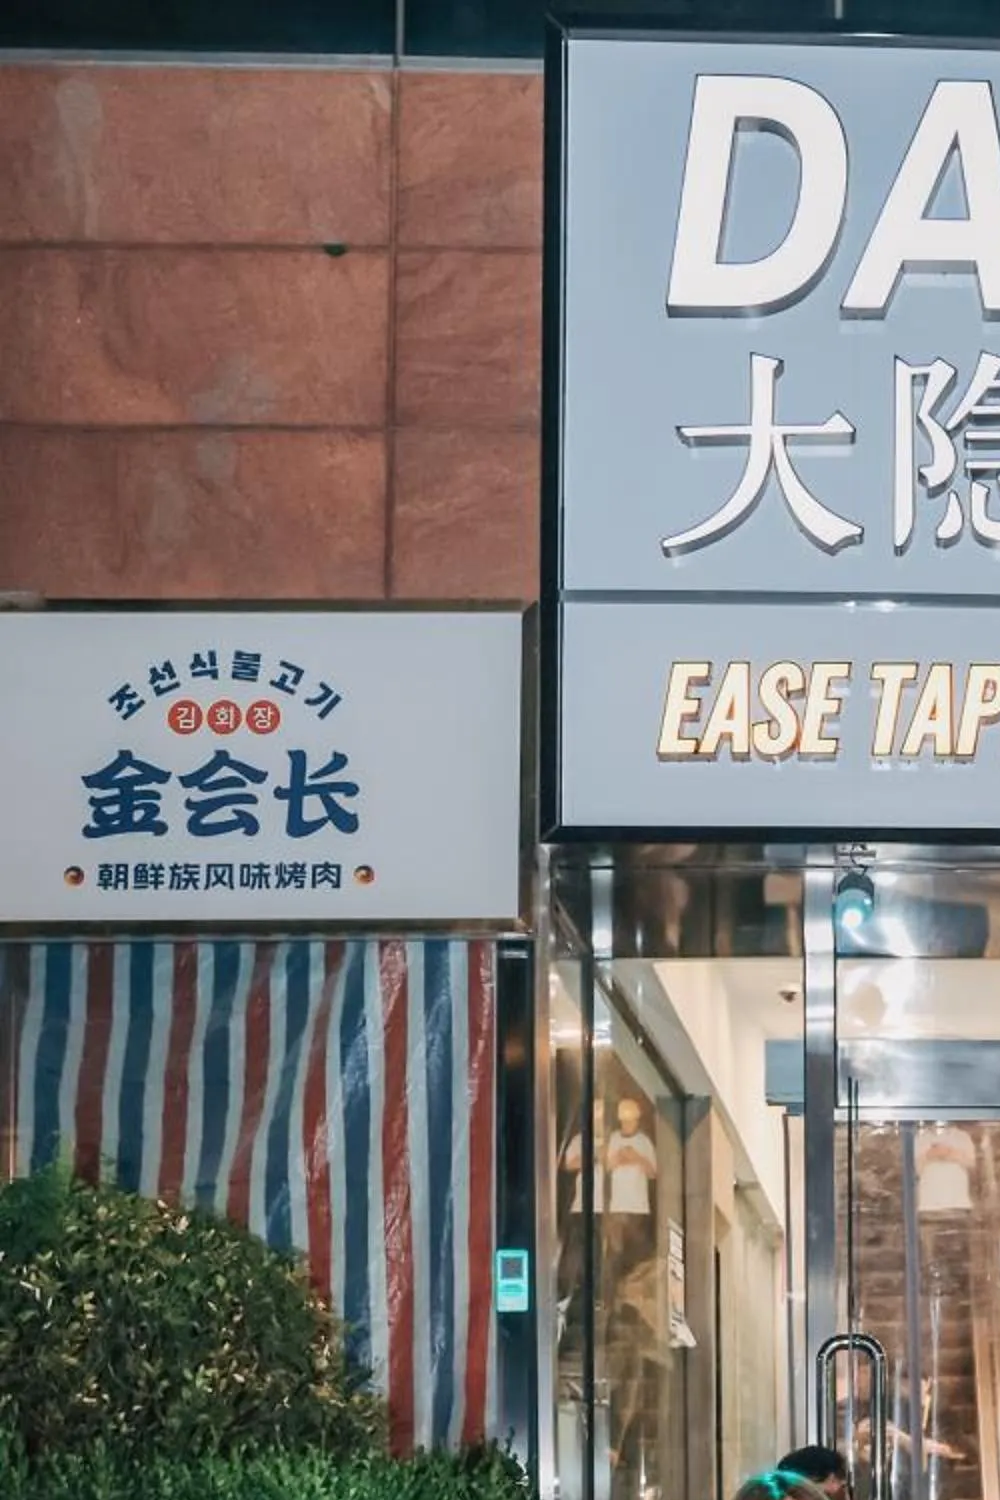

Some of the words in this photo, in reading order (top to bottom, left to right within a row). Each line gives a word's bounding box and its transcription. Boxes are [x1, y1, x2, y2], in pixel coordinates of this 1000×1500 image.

[172, 703, 277, 732] 김회장
[656, 661, 852, 762] EASE
[81, 750, 360, 838] 金会长
[97, 862, 342, 891] 朝鲜族风味烤肉
